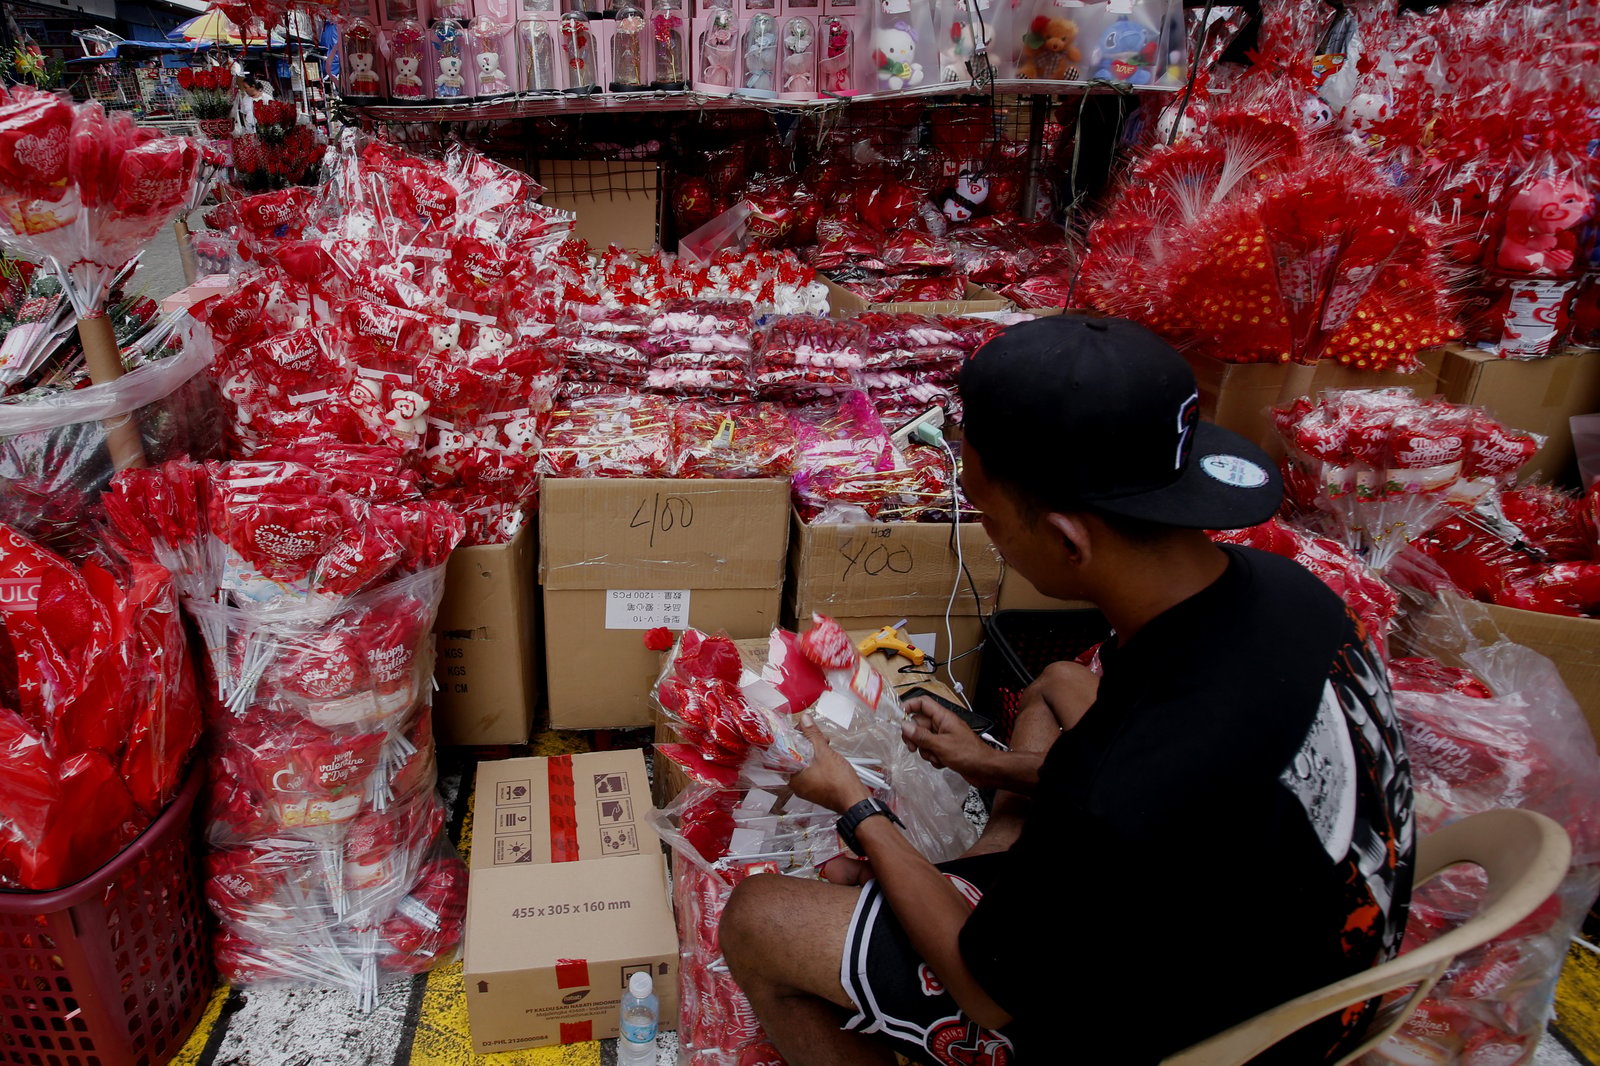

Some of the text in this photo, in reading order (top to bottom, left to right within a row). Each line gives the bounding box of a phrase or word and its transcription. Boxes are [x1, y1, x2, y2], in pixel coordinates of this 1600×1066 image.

[1489, 429, 1524, 455] Happy
[630, 493, 693, 547] 400
[262, 531, 315, 547] Happy
[838, 538, 913, 581] 400
[368, 644, 405, 663] Happy
[445, 648, 463, 658] KGS
[447, 666, 466, 676] KGS
[454, 683, 468, 693] CM
[1410, 721, 1471, 767] Happy
[512, 900, 631, 918] 455 x 305 x 160 mm
